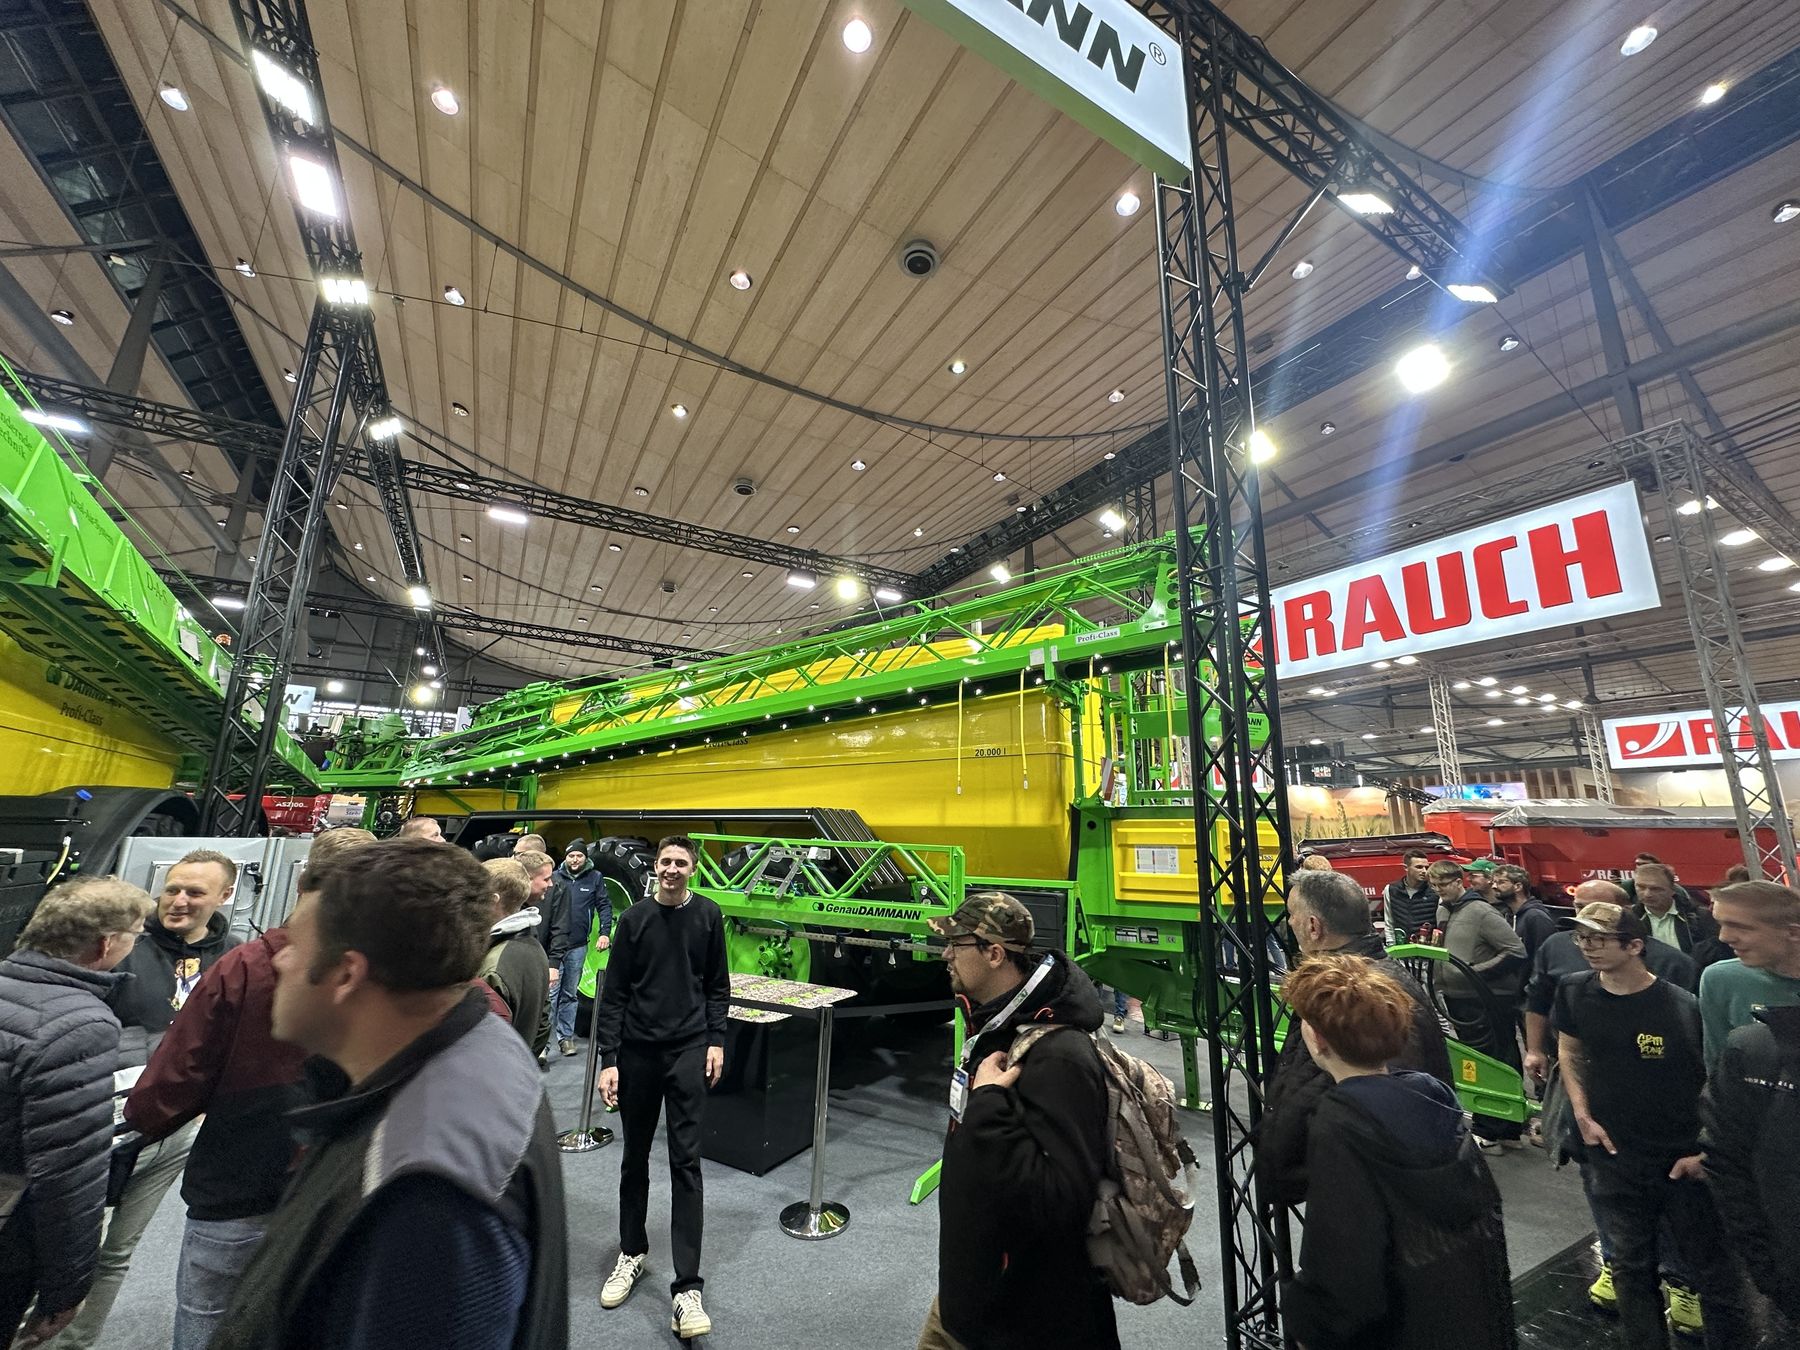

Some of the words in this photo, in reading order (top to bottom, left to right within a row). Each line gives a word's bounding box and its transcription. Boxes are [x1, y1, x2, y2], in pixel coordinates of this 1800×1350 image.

[1284, 509, 1622, 662] RAUCH
[1077, 630, 1118, 643] Profi-Class
[825, 903, 922, 920] GenauDAMMANN
